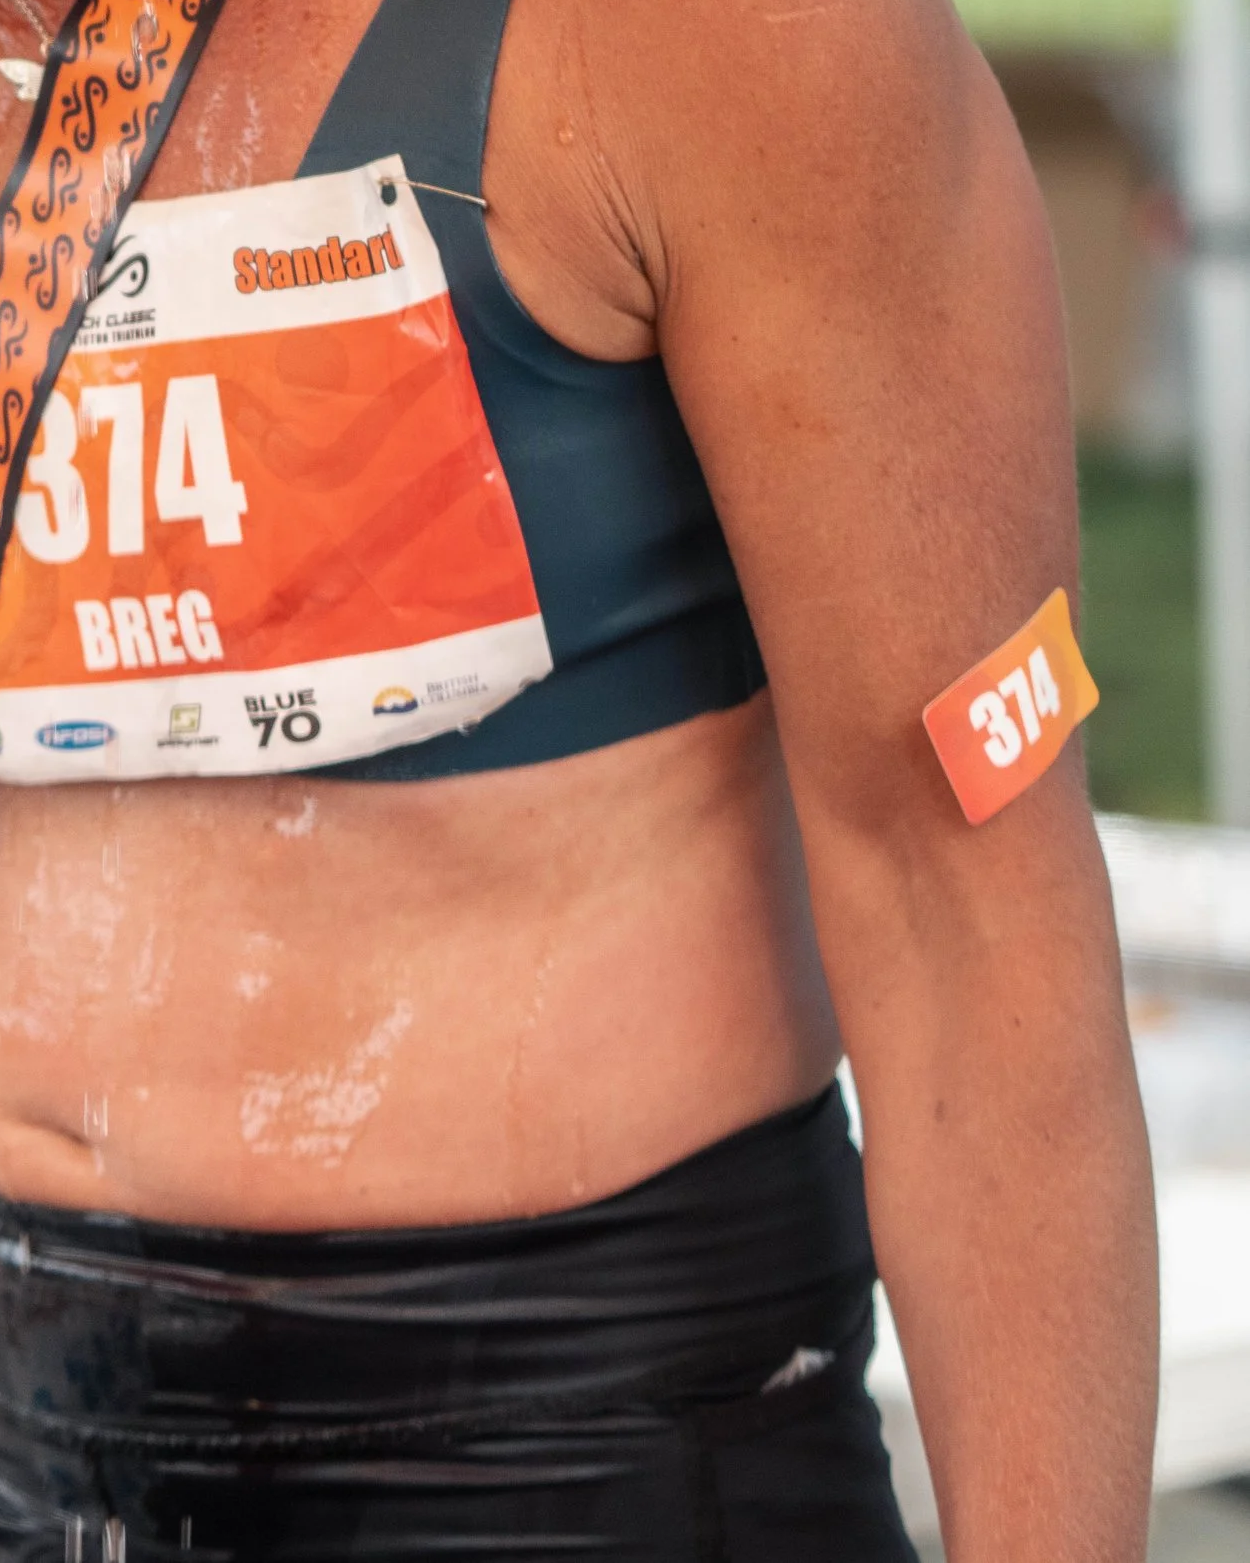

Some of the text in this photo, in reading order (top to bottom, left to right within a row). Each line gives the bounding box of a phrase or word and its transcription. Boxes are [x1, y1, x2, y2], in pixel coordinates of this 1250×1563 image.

[16, 373, 248, 565] 374
[73, 589, 224, 672] BREG
[244, 688, 317, 713] BLUE
[252, 710, 321, 748] 70
[968, 645, 1062, 769] 374
